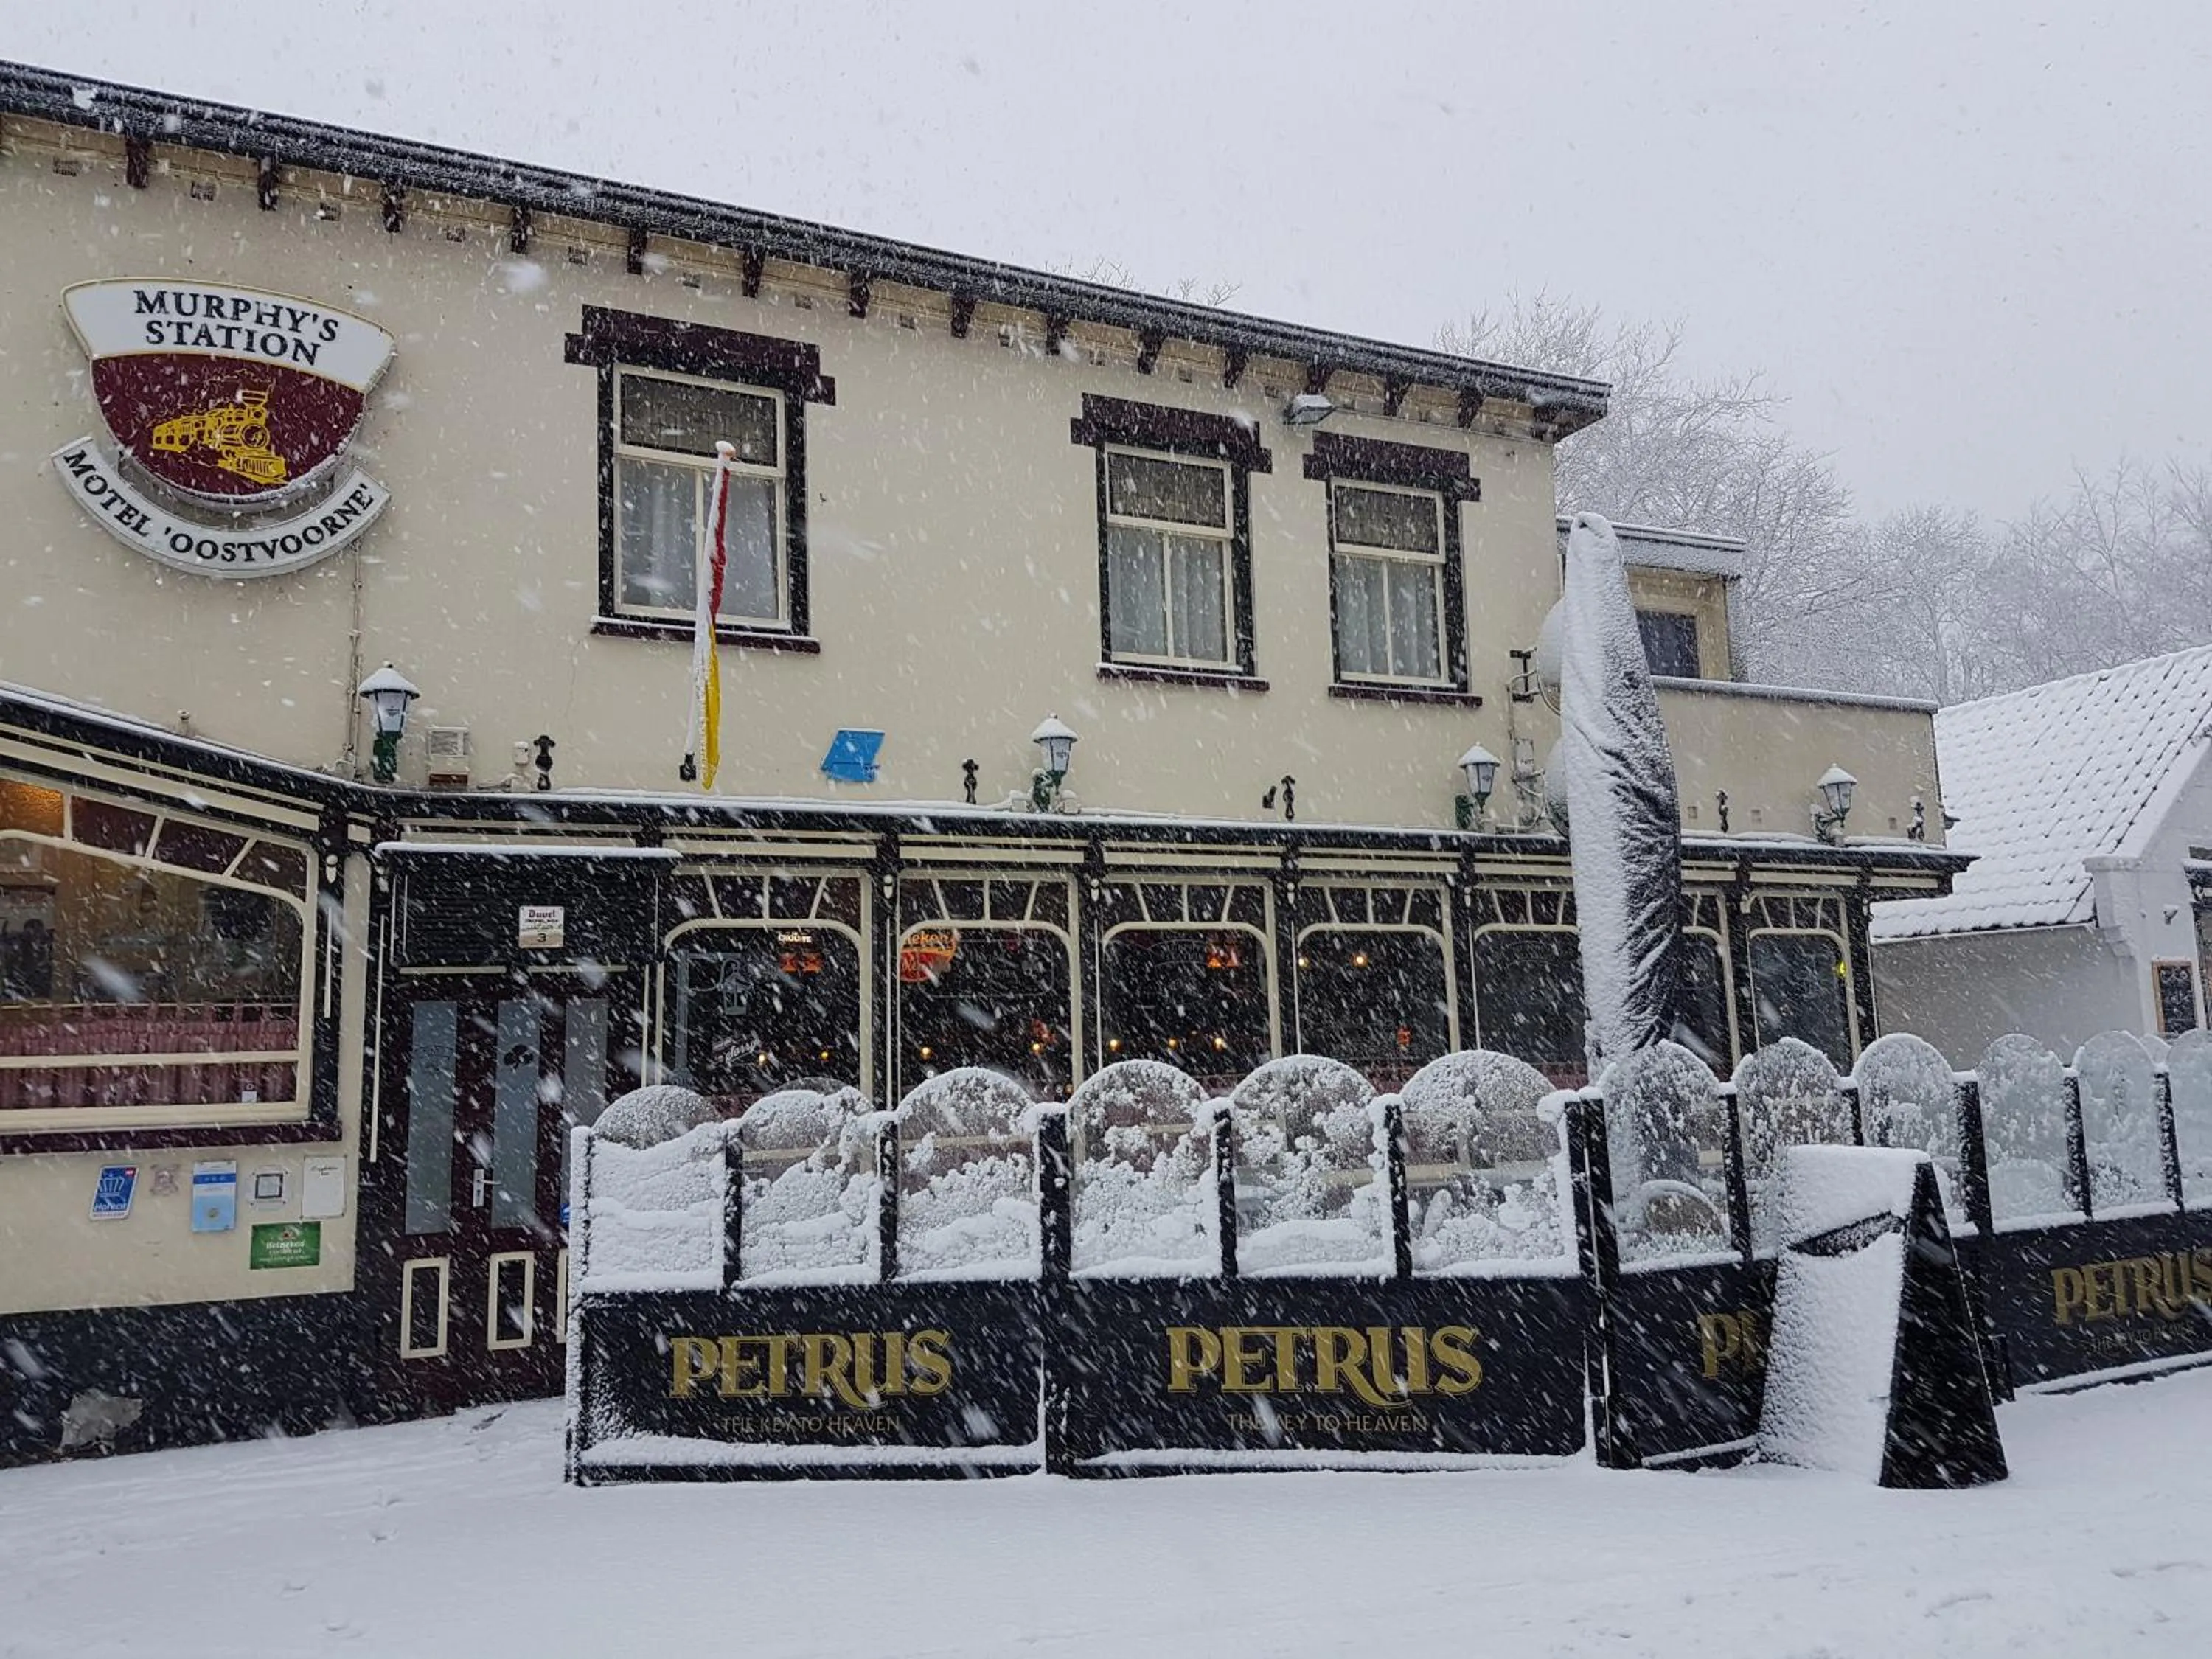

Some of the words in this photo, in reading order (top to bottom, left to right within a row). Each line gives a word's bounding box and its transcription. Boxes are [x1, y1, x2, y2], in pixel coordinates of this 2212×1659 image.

[133, 290, 339, 342] MURPHY'S
[146, 320, 321, 366] STATION
[63, 449, 150, 537] MOTEL
[164, 483, 374, 562] 'OOSTVOORNE'
[529, 909, 555, 918] Duvel
[2051, 1247, 2212, 1325] PETRUS
[669, 1329, 952, 1410] PETRUS
[1166, 1326, 1483, 1409] PETRUS
[723, 1416, 754, 1433] THE
[760, 1416, 792, 1433] KEY
[799, 1416, 822, 1433] TO
[829, 1415, 900, 1433] HEAVEN
[1313, 1414, 1340, 1431] TO
[1346, 1414, 1428, 1432] HEAVEN
